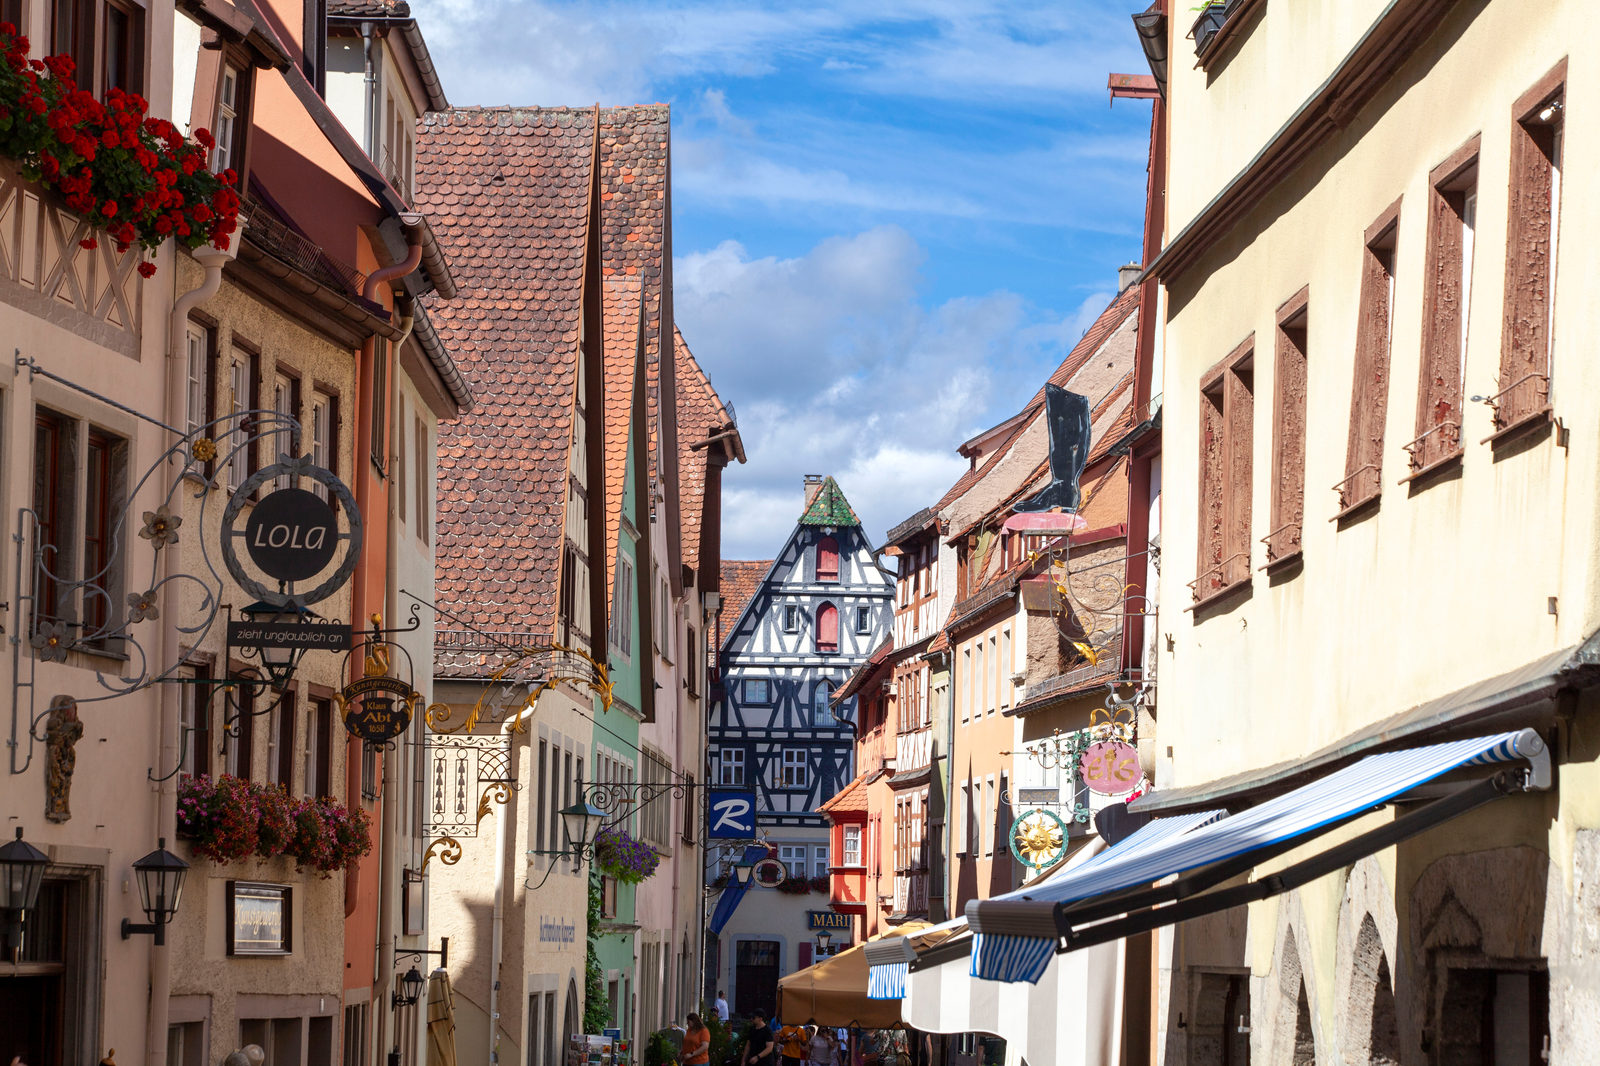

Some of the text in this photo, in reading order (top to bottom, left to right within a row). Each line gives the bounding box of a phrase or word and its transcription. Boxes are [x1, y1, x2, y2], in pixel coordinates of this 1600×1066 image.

[237, 629, 343, 643] zieht unglaublich an
[366, 701, 387, 711] Klaus
[363, 712, 391, 723] Abt
[713, 798, 752, 832] R.
